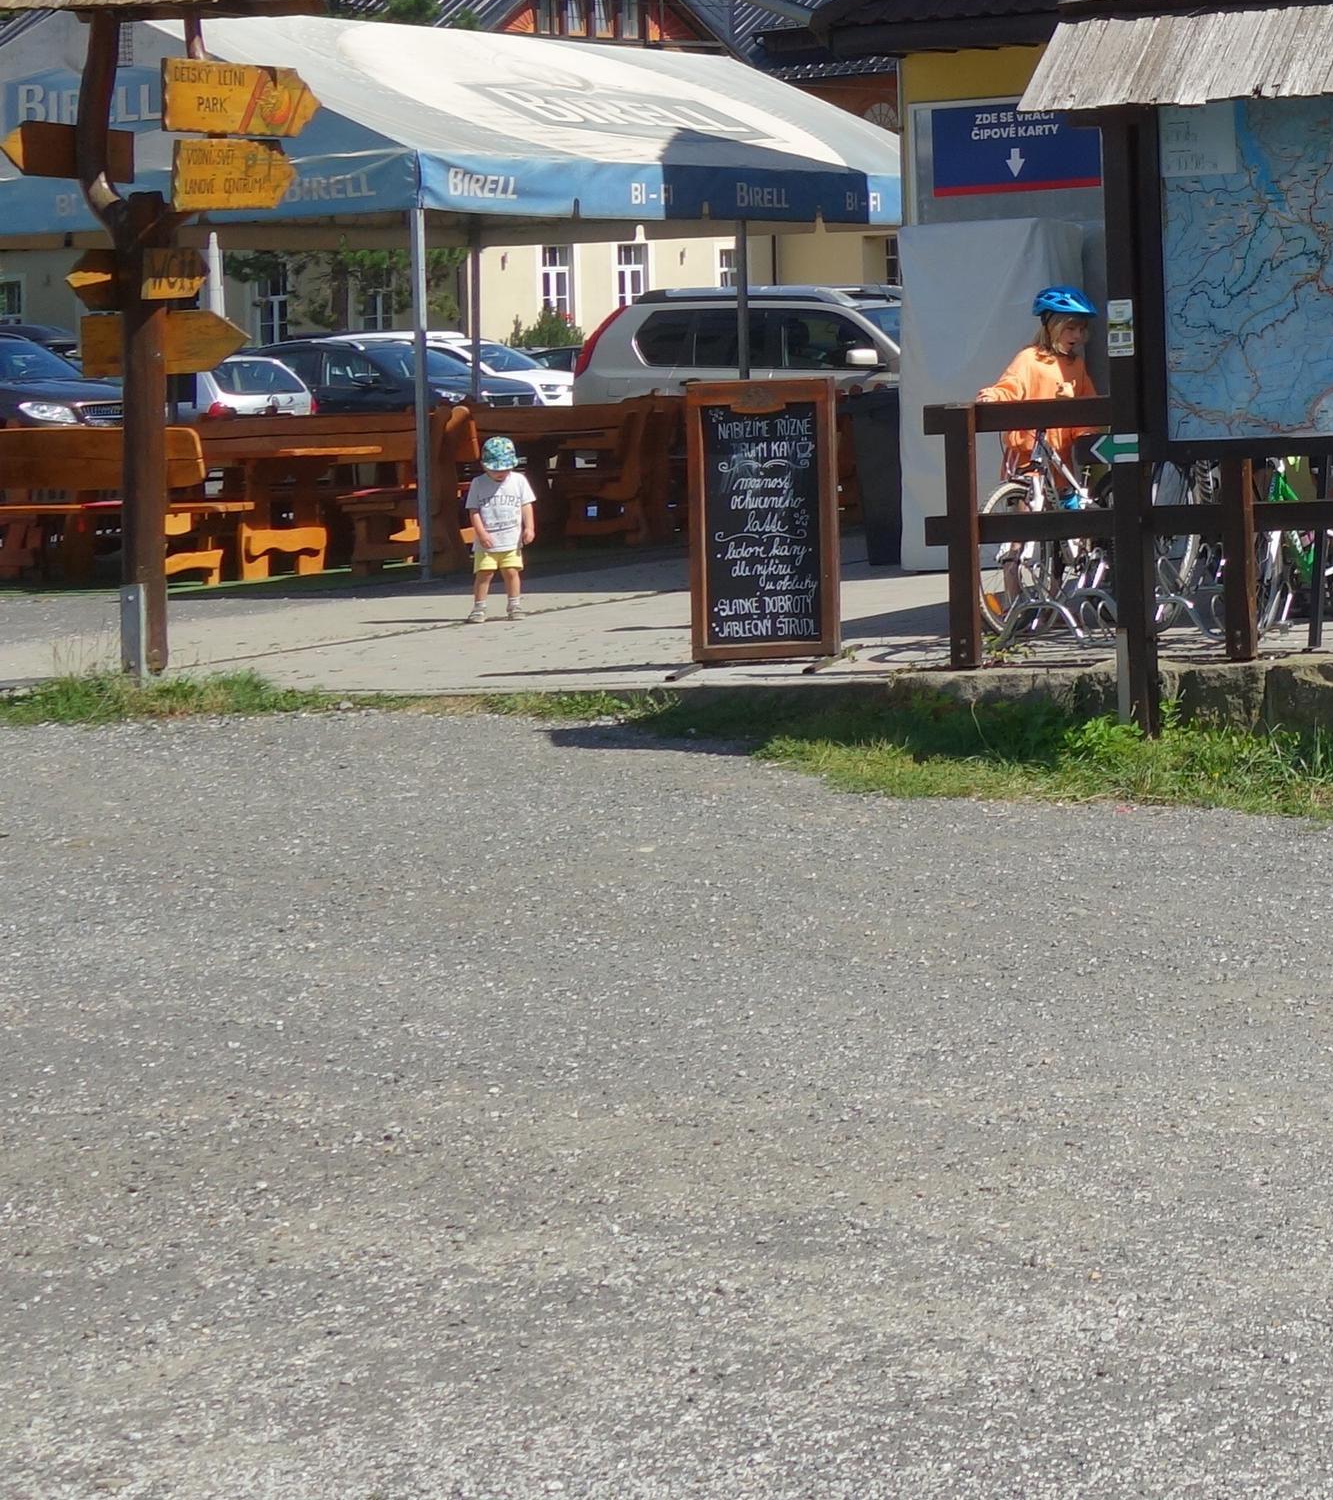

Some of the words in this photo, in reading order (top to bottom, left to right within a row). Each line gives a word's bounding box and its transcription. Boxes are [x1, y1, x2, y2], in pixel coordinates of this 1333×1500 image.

[196, 95, 229, 115] PARK
[486, 86, 752, 134] BIRELL
[975, 113, 998, 125] ZDE
[1000, 111, 1014, 124] SE
[971, 124, 1016, 141] ČIPOVÉ
[1018, 123, 1060, 138] KARTY
[448, 168, 518, 200] BIRELL
[736, 182, 790, 209] BIRELL
[717, 416, 771, 441] NABÍZÍME
[775, 412, 814, 438] RŮZNÉ
[731, 560, 751, 577] dle
[717, 591, 761, 616] SLADKÉ
[762, 594, 813, 615] DOBROTY
[718, 614, 772, 638] JABLEČNÝ
